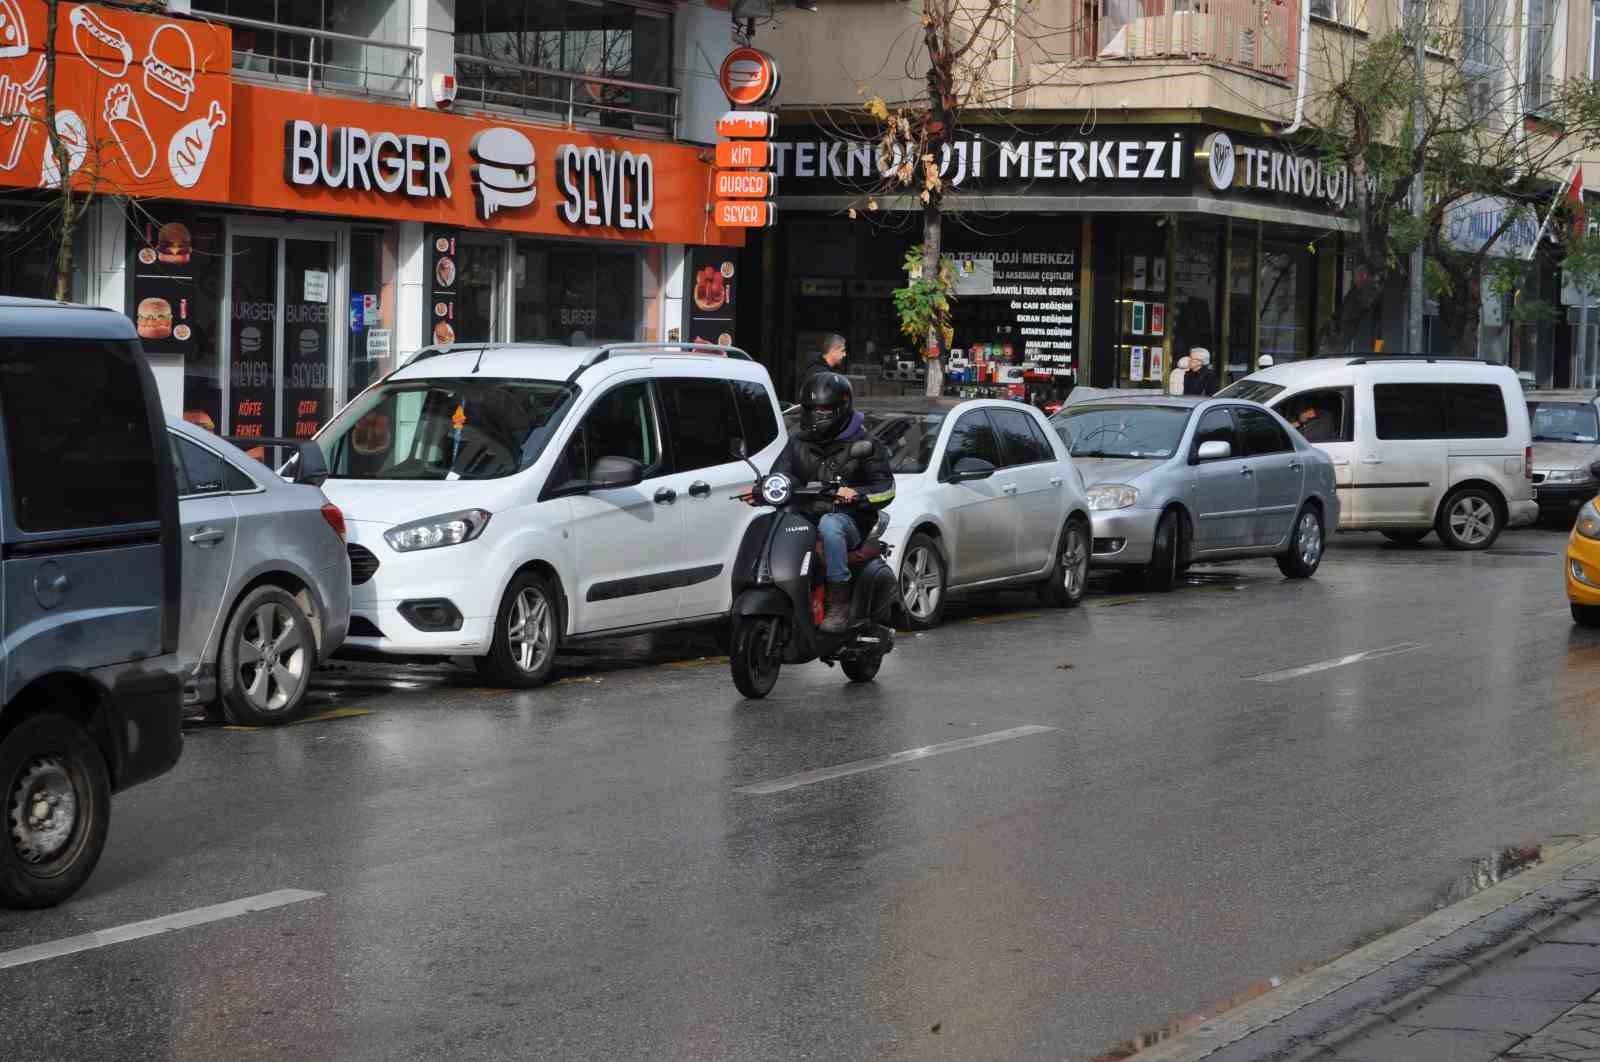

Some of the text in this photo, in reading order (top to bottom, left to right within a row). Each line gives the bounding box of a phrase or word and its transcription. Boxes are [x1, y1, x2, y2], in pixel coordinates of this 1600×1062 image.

[288, 119, 453, 199] BURGER
[731, 145, 752, 165] KİM
[1000, 132, 1182, 183] MERKEZİ
[560, 144, 655, 230] SEVER
[720, 175, 763, 193] BURGER
[723, 205, 758, 223] SEVER
[992, 285, 1022, 295] ARANTİLİ
[231, 302, 276, 320] URGER
[238, 400, 263, 416] KÖFTE
